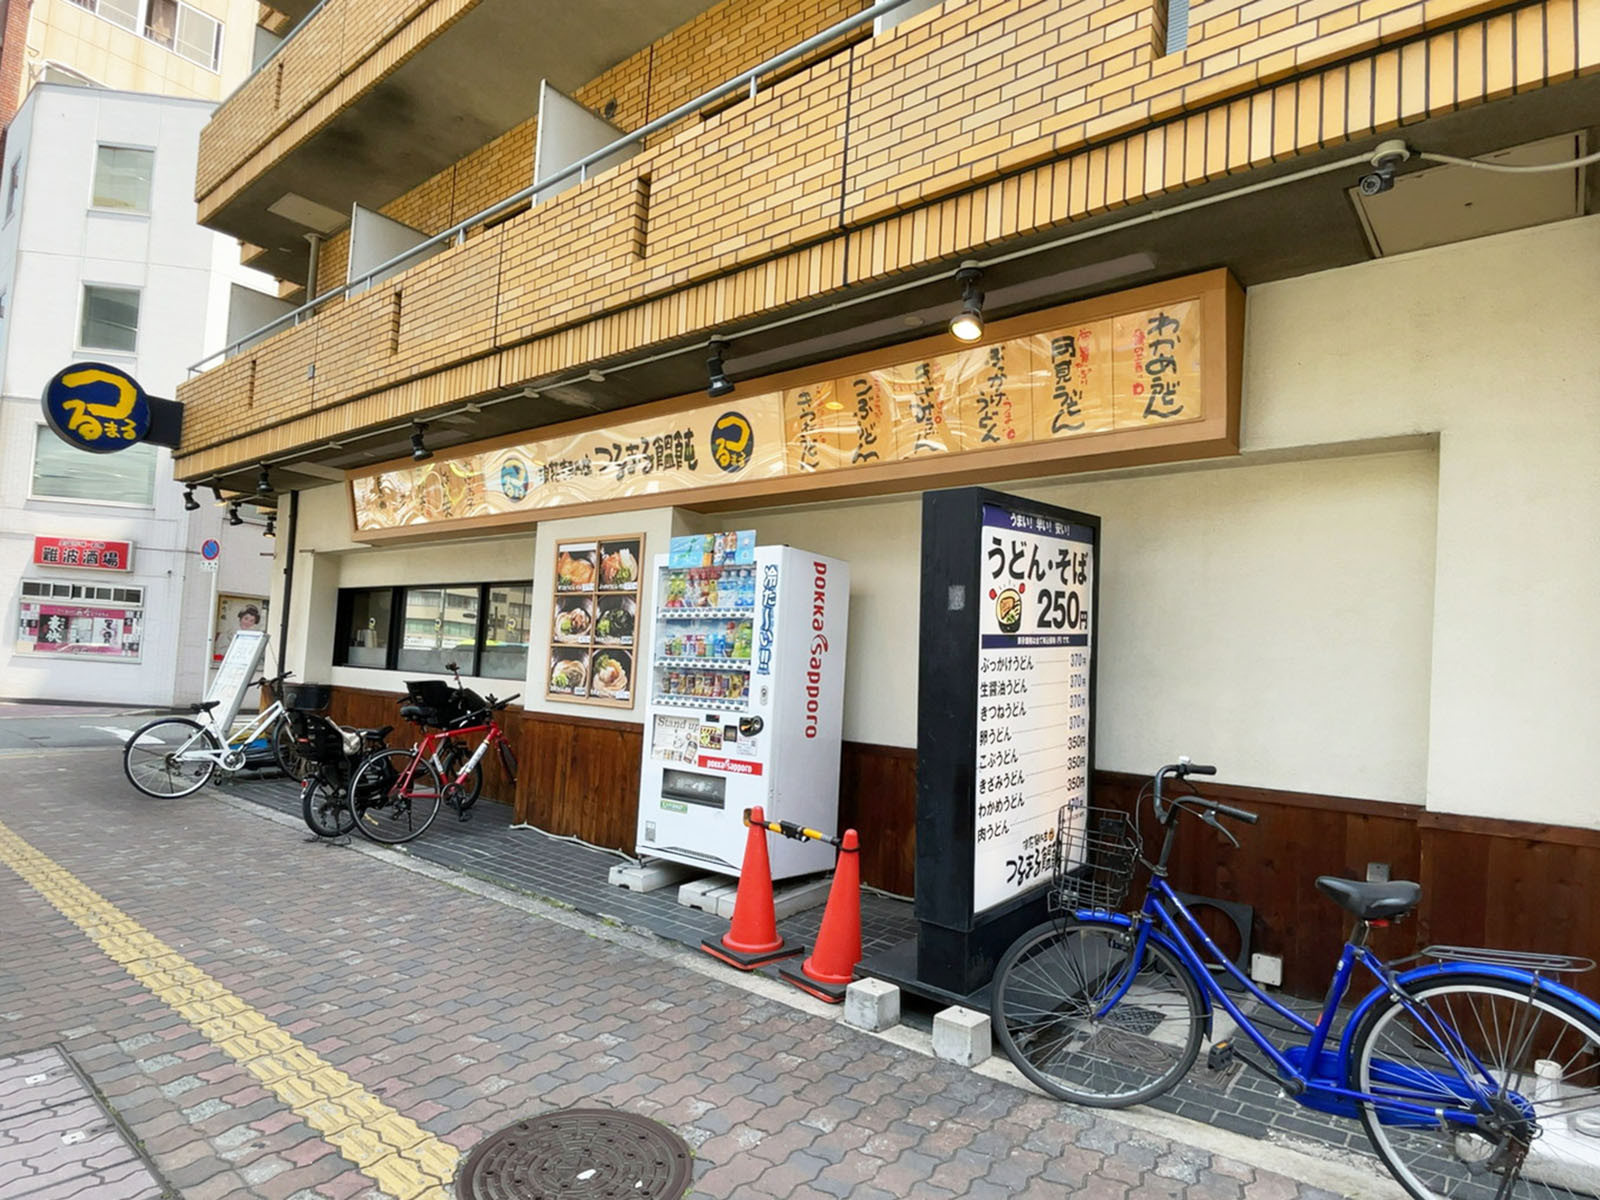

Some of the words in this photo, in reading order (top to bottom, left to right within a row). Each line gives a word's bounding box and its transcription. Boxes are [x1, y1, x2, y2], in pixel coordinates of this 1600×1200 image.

[42, 546, 119, 568] 難波酒場
[988, 537, 1088, 585] うどん・そば
[1037, 588, 1088, 630] 250円
[980, 656, 1034, 673] ぶっかけうどん
[980, 678, 1028, 698] 生醤油うどん
[980, 701, 1027, 722] きつねうどん
[657, 717, 687, 729] Stand
[979, 726, 1012, 746] 卵うどん
[979, 748, 1019, 769] こぶうどん
[1067, 735, 1086, 750] 350円
[979, 770, 1025, 794] きざみうどん
[1067, 755, 1086, 771] 350円
[978, 792, 1025, 818] わかめうどん
[1066, 775, 1085, 792] 350円
[977, 823, 1010, 844] 肉うどん
